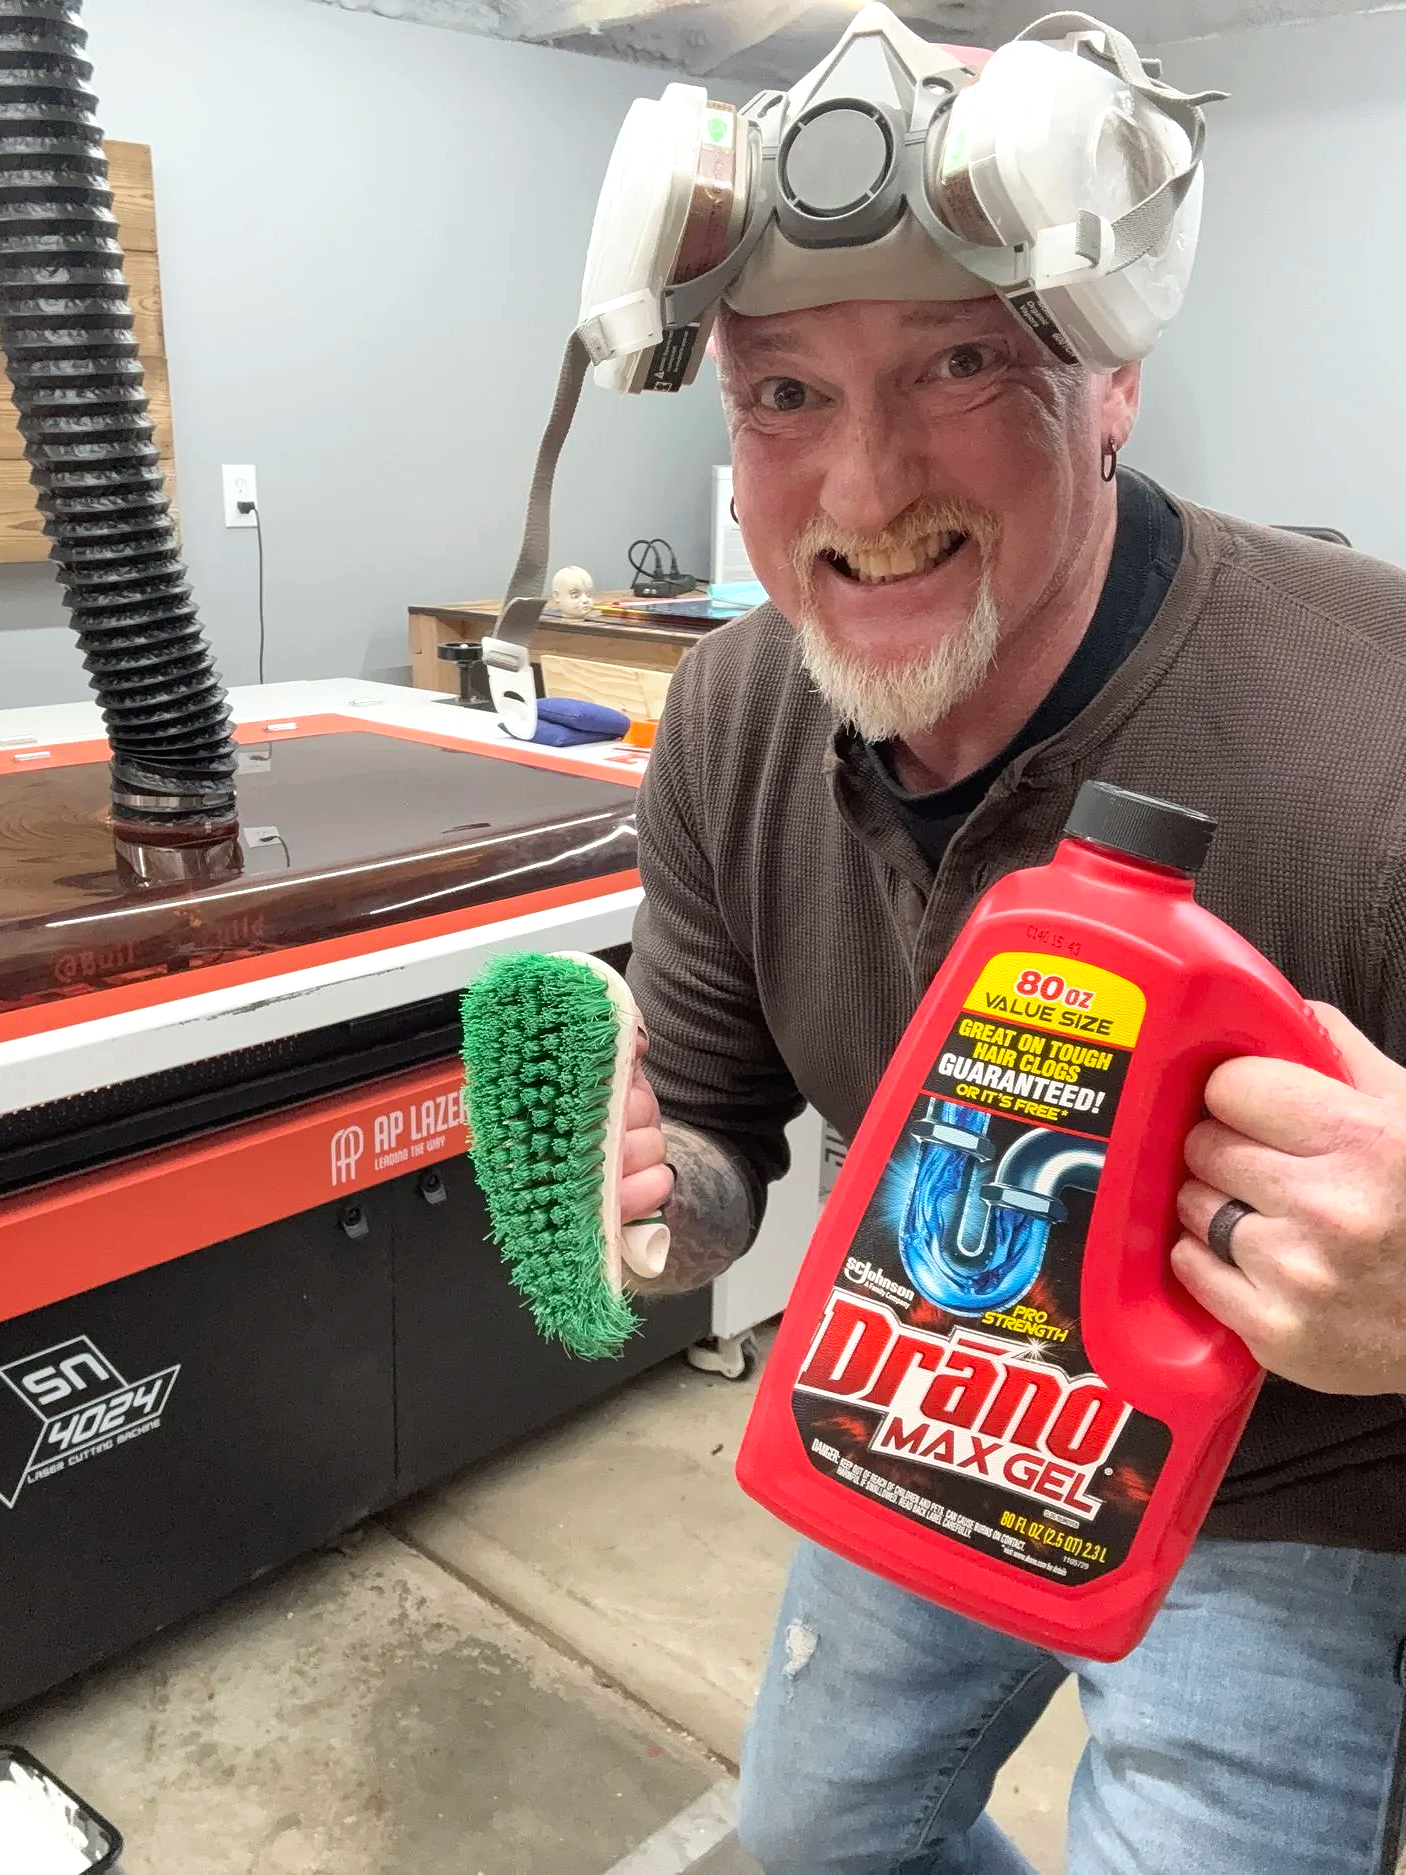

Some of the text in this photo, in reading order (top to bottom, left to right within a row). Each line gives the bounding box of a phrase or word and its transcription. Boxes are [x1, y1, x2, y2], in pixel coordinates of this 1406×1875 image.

[1016, 970, 1065, 1001] 80
[986, 992, 1114, 1036] VALUE SIZE
[959, 1019, 1114, 1071] GREAT ON TOUGH
[973, 1041, 1081, 1083] HAIR CLOGS
[937, 1052, 1106, 1114] GUARANTEED!
[956, 1083, 980, 1098] OR
[980, 1088, 1014, 1108] IT'S
[374, 1110, 404, 1153] AP
[374, 1136, 446, 1171] LEADING THE WAY
[982, 1312, 1069, 1342] STRENGTH
[1012, 1305, 1048, 1323] PRO
[48, 1379, 163, 1450] 4024
[27, 1418, 161, 1484] LASER CUTTING MACHINE
[880, 1417, 1092, 1513] MAX GEL
[1000, 1511, 1108, 1563] 80 FL OZ (2.5 QT) 2.3 L
